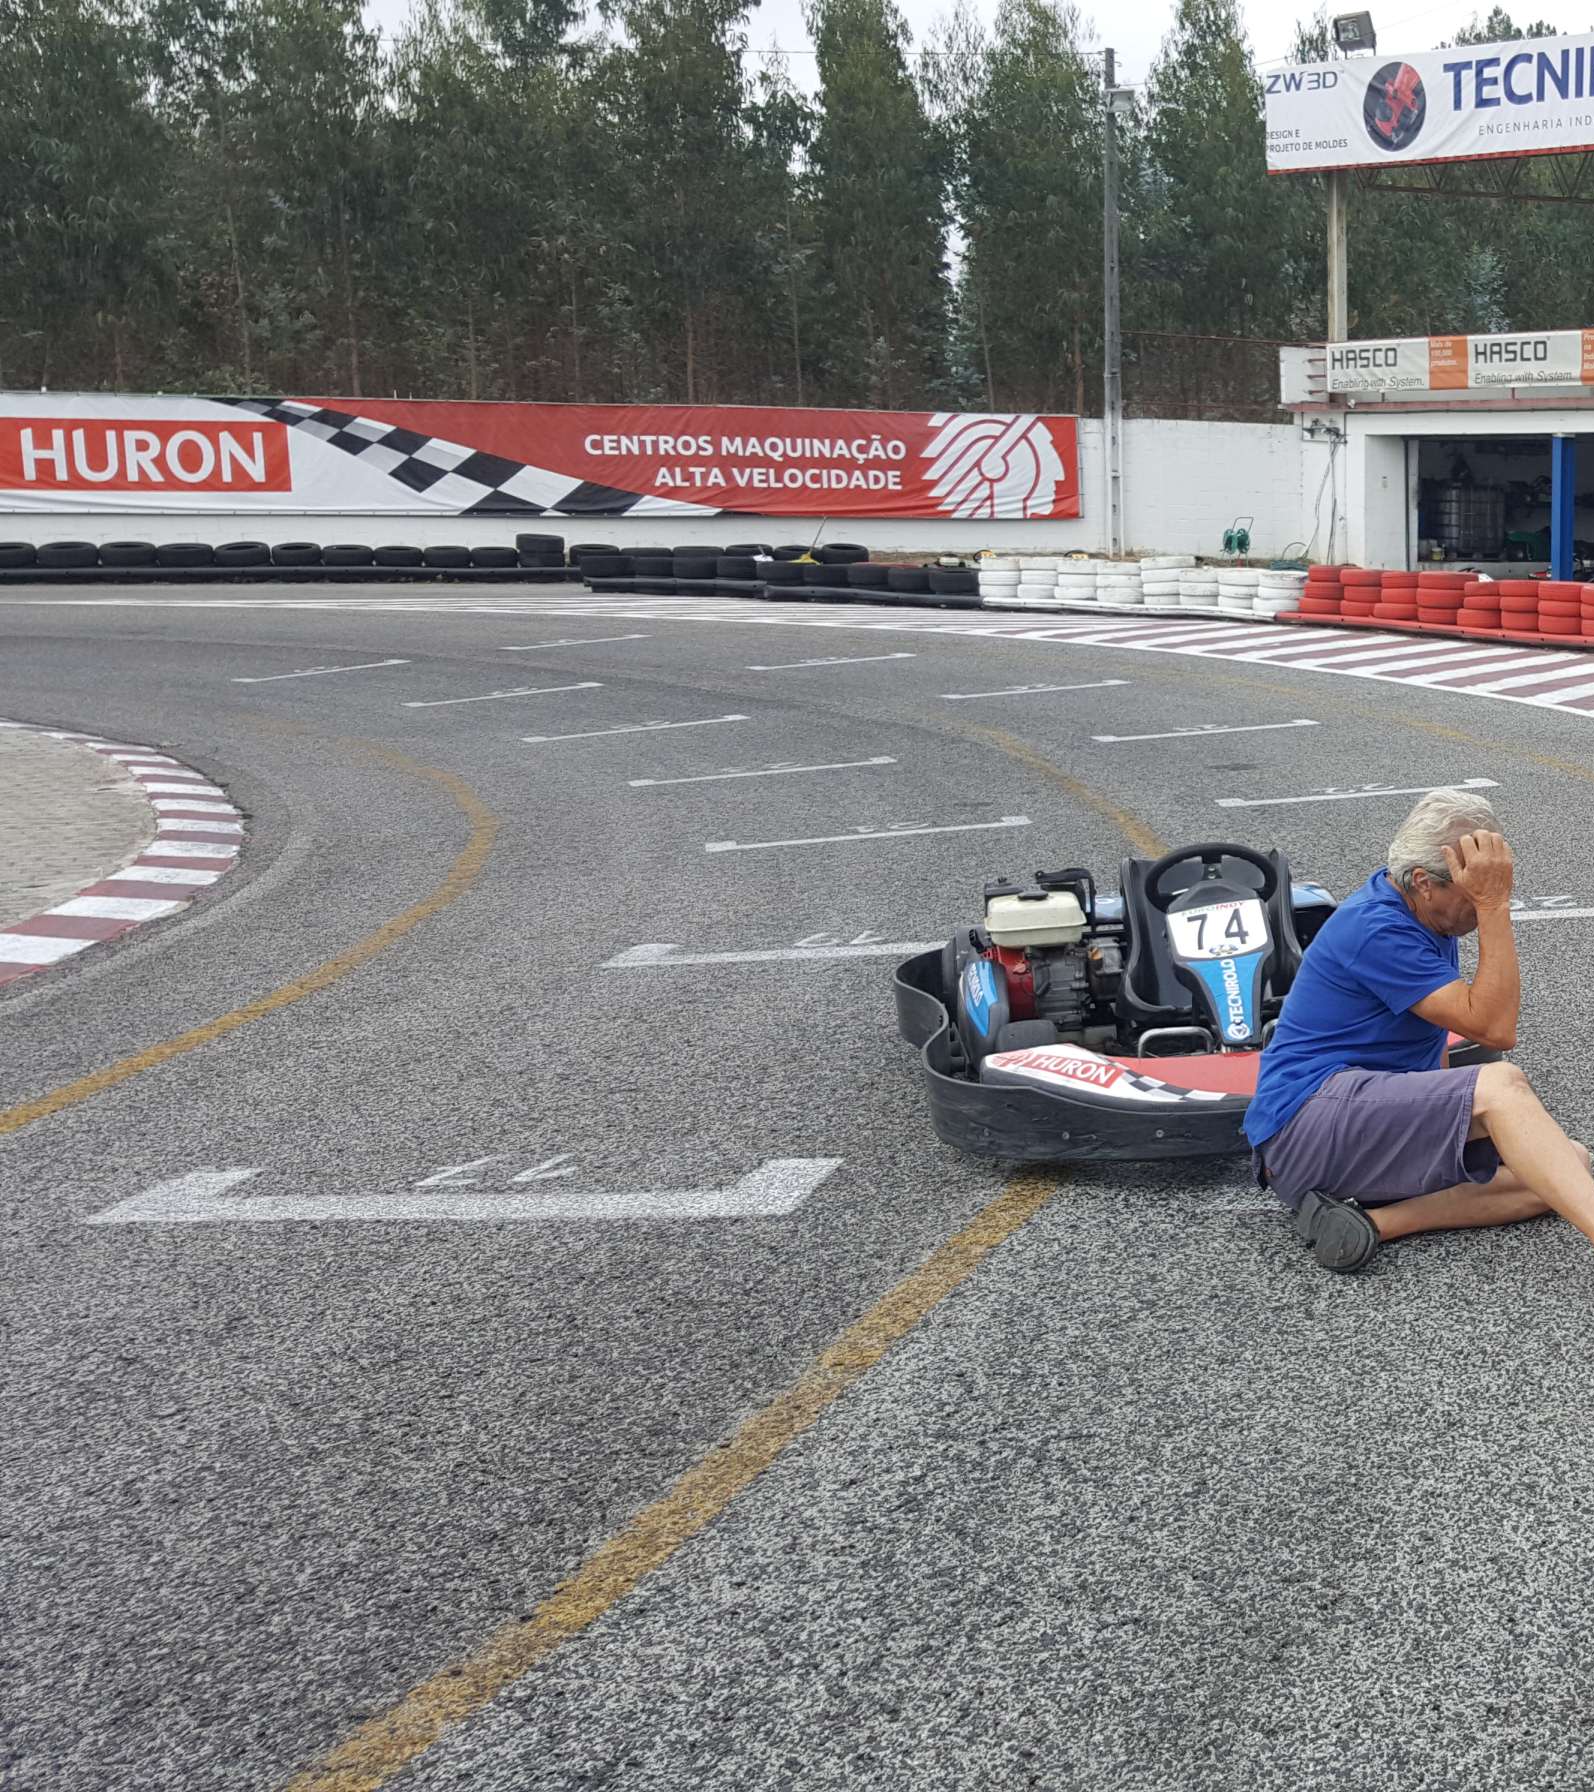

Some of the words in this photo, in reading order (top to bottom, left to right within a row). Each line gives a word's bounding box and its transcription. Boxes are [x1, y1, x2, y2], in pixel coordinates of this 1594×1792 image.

[1295, 129, 1301, 138] E
[1478, 117, 1562, 136] ENGENHARIA
[1302, 141, 1313, 151] DE
[1315, 139, 1348, 150] MOLDES
[1332, 347, 1397, 370] HASCO
[1474, 340, 1548, 363] HASCO
[20, 427, 266, 484] HURON
[584, 434, 714, 456] CENTROS
[721, 434, 907, 463] MAQUINAÇÃO
[654, 466, 726, 488] ALTA
[734, 467, 902, 490] VELOCIDADE
[1187, 908, 1249, 950] 74
[1220, 958, 1244, 1022] TECNIROLO
[1032, 1055, 1116, 1084] HURON
